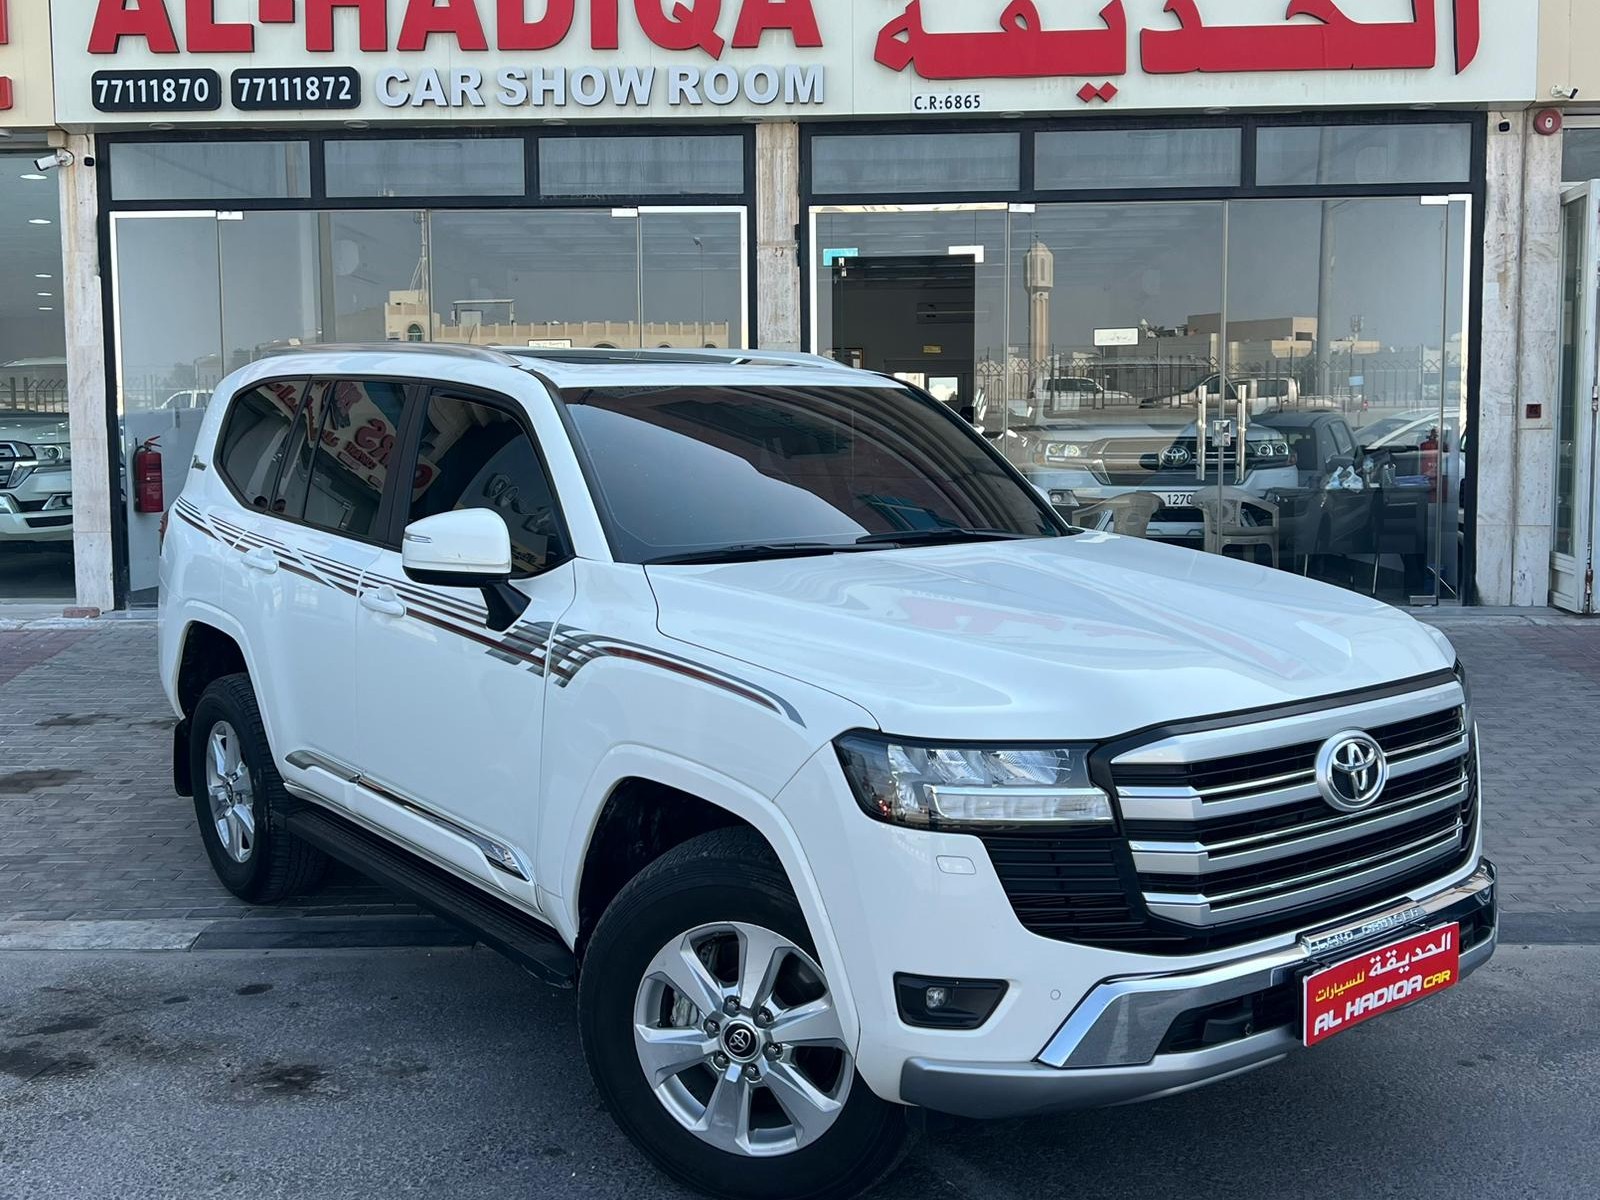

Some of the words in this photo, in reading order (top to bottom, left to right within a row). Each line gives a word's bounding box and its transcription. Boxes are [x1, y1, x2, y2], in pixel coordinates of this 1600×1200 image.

[96, 78, 210, 104] 77111870
[237, 76, 352, 102] 77111872
[375, 67, 486, 108] CAR
[495, 65, 656, 107] SHOW
[668, 64, 825, 106] ROOM
[914, 94, 981, 110] C.R:6865
[1368, 931, 1452, 977] الحديقة
[1315, 970, 1365, 1002] للسيارات
[1314, 1009, 1342, 1036] AL
[1423, 969, 1451, 989] CAR
